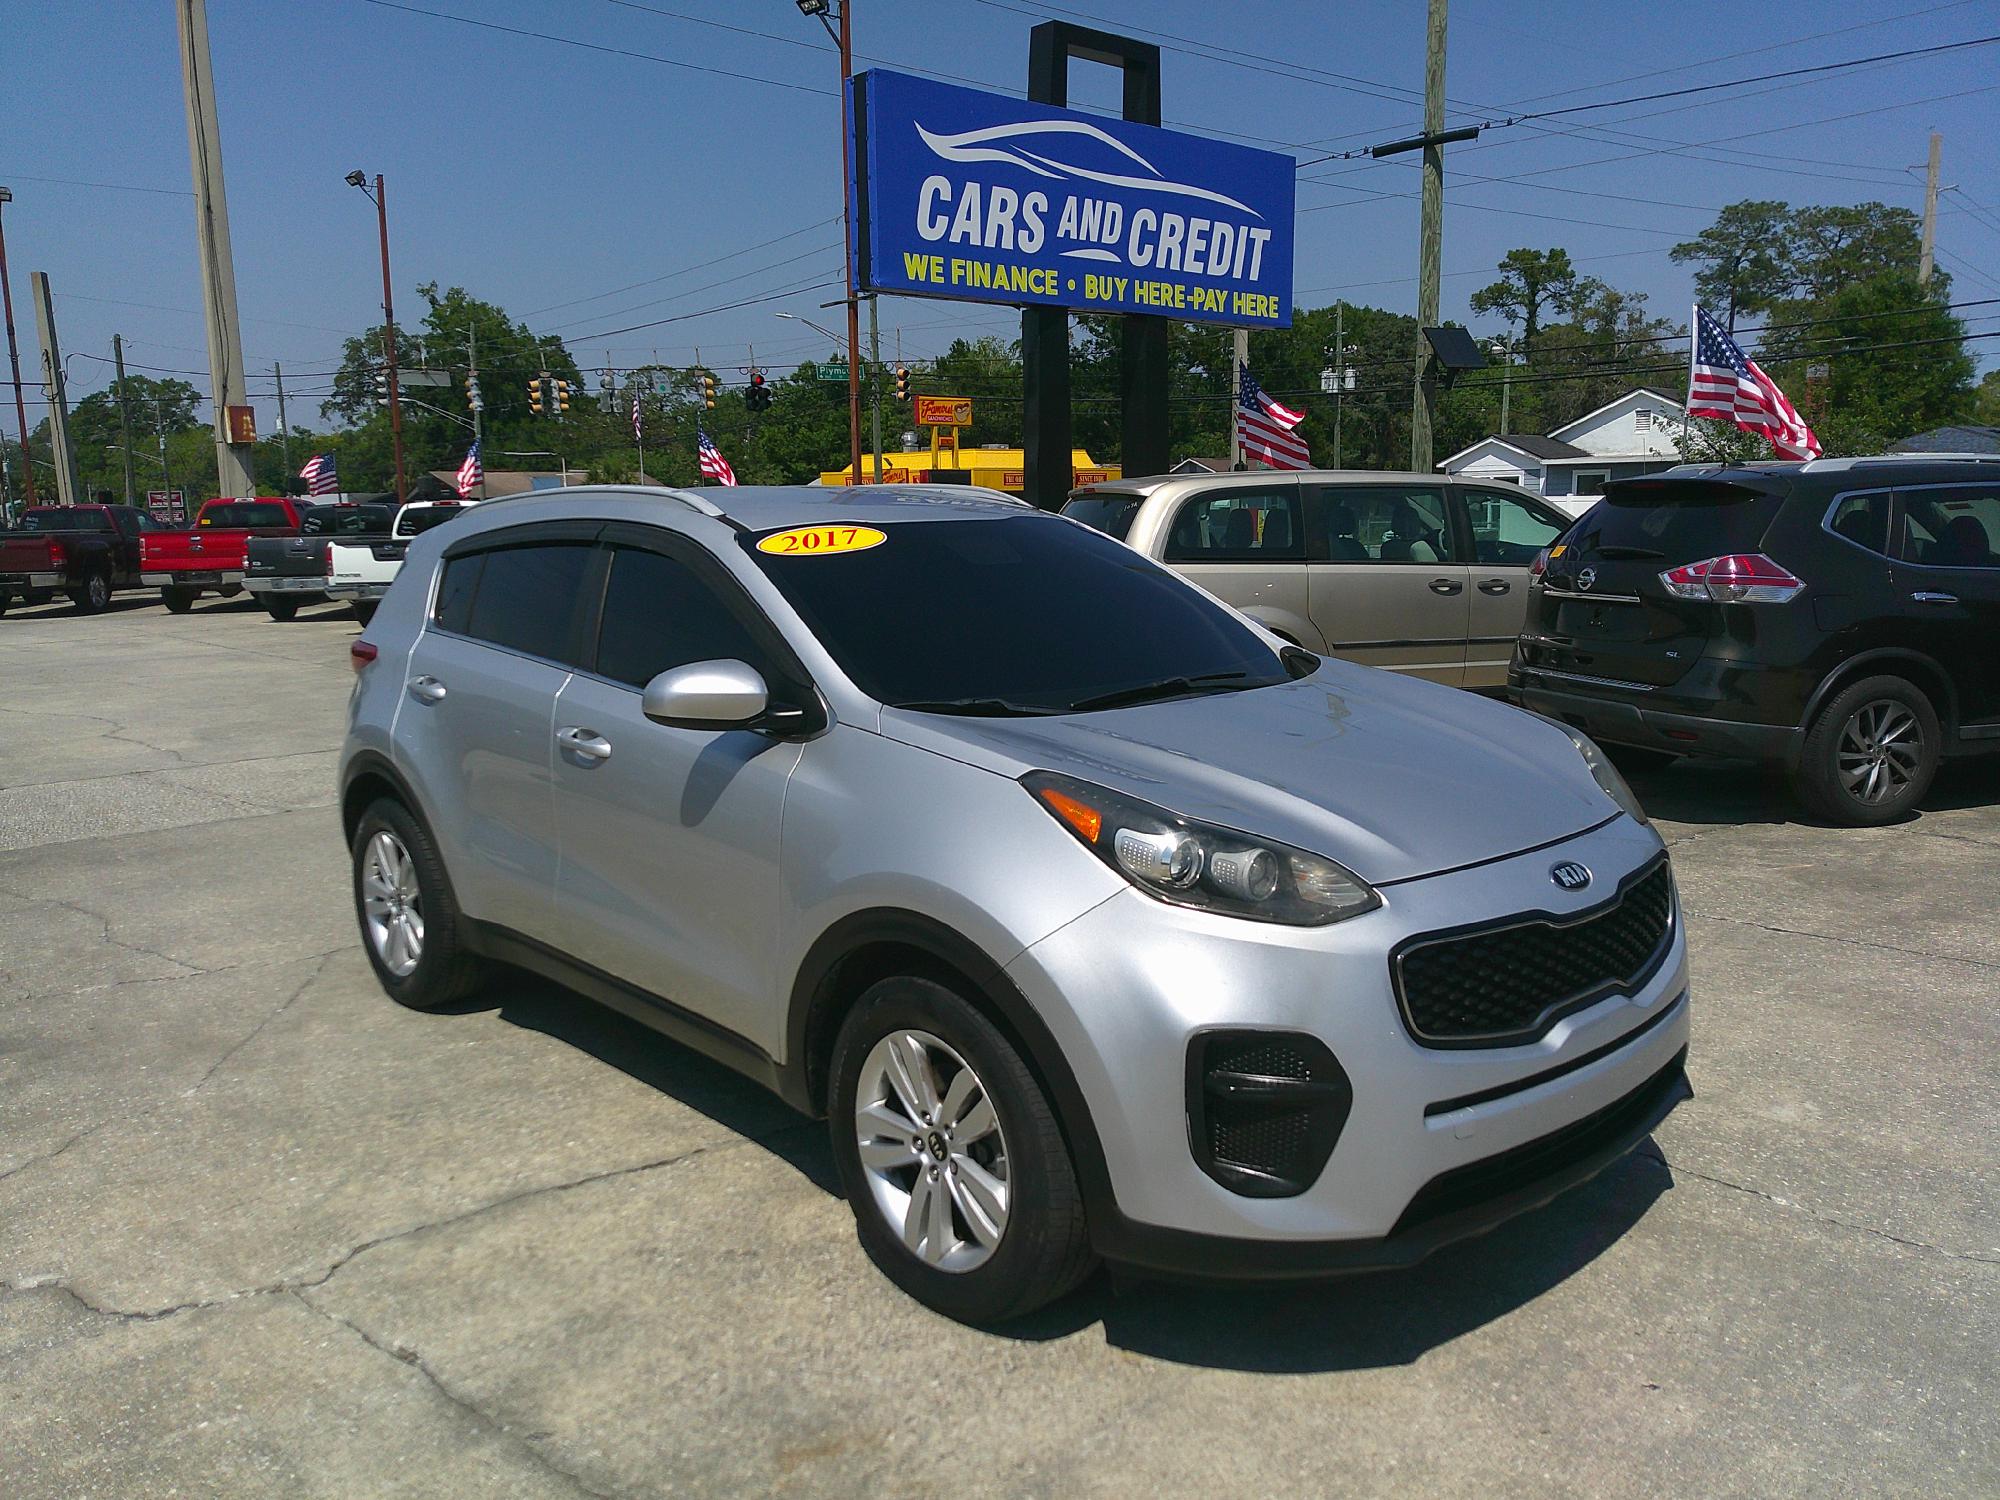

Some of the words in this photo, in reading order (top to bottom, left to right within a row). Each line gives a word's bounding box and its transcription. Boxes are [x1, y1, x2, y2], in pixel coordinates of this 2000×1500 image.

[916, 175, 1048, 254] CARS
[1056, 195, 1123, 244] AND
[1128, 208, 1271, 281] CREDIT
[903, 252, 945, 284] WE
[951, 258, 1059, 296] FINANCE
[1085, 273, 1128, 302] BUY
[1232, 291, 1279, 319] HERE
[819, 366, 860, 376] Plymo
[781, 529, 858, 552] 2017
[1666, 651, 1681, 659] SL
[1554, 864, 1589, 887] KIA
[929, 1134, 943, 1160] KIA
